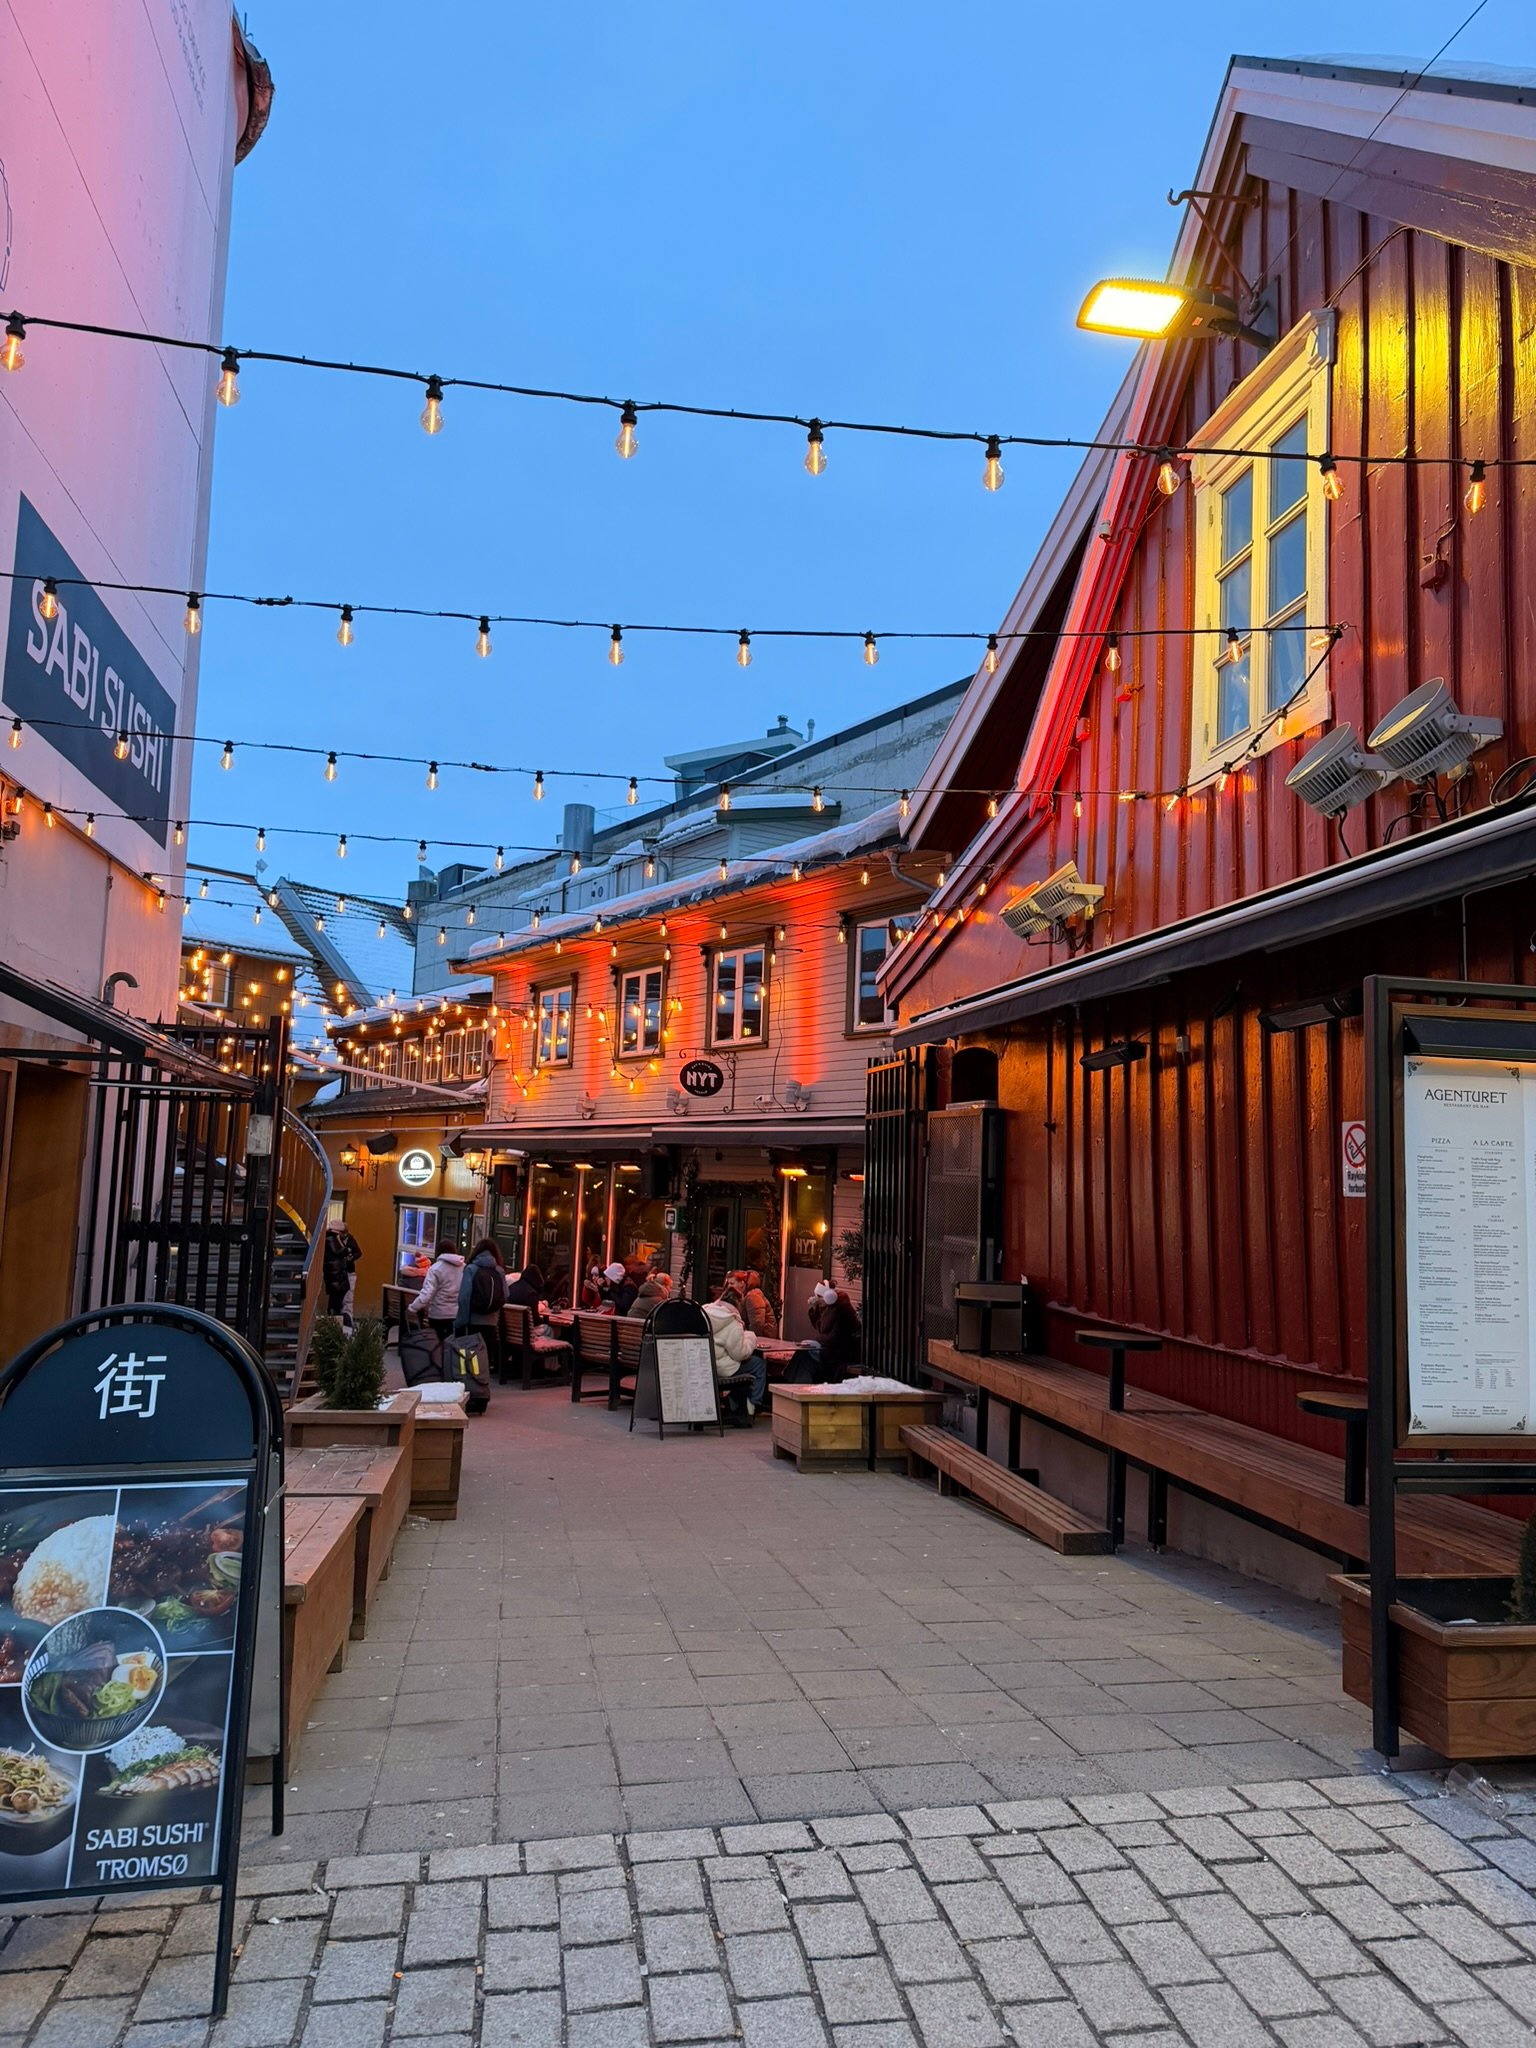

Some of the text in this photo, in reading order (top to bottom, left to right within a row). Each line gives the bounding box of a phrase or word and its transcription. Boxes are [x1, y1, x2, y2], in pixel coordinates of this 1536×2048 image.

[27, 579, 166, 793] SABI SUSHI
[686, 1070, 718, 1088] NYT
[1424, 1088, 1508, 1104] AGENTURET
[1431, 1137, 1451, 1145] PIZZA
[543, 1228, 558, 1244] NYT
[711, 1233, 727, 1249] NYT
[795, 1237, 817, 1256] NYT
[93, 1352, 167, 1420] 街
[85, 1822, 203, 1851] SABI SUSHI
[96, 1854, 188, 1880] TROMSØ
